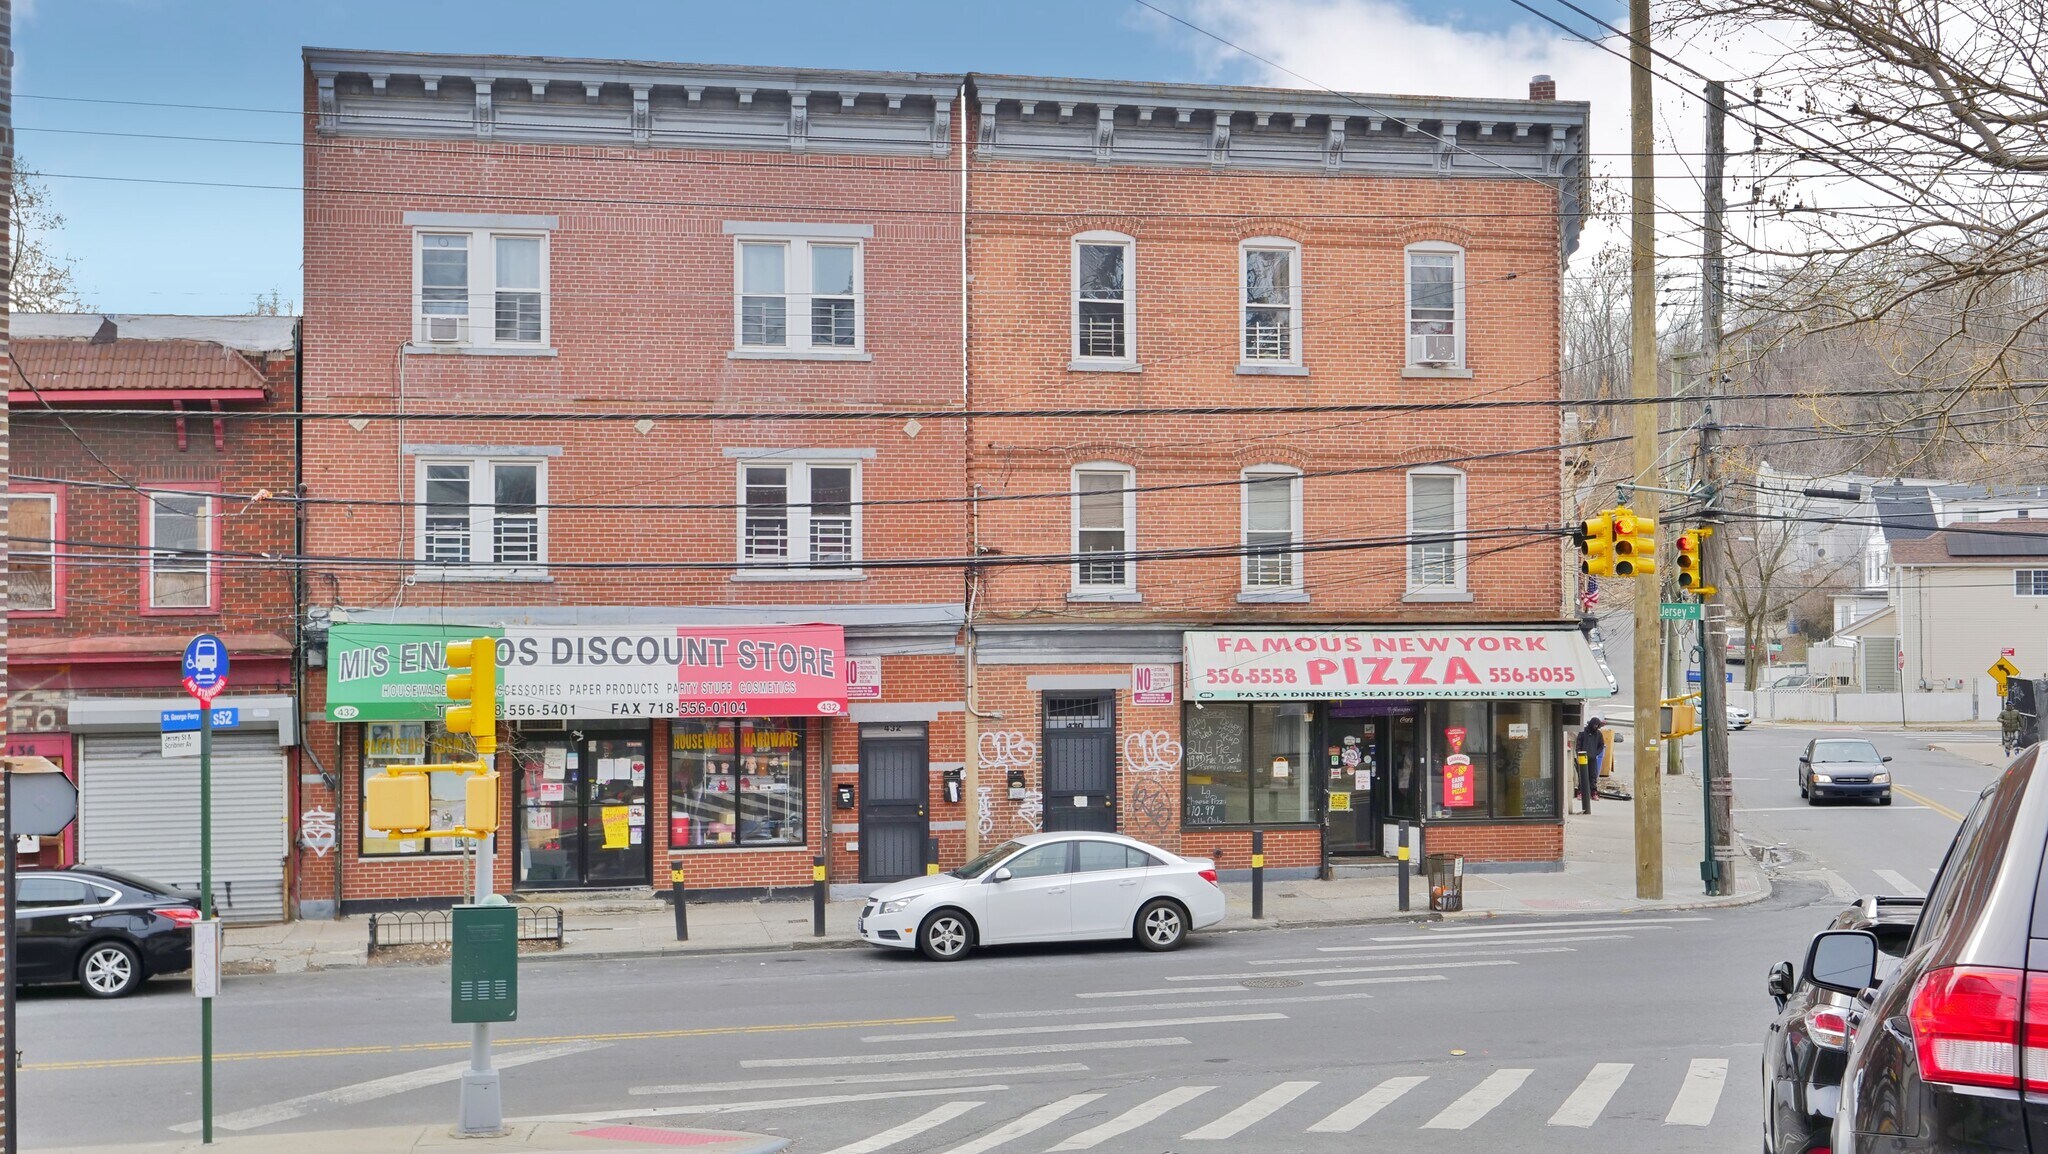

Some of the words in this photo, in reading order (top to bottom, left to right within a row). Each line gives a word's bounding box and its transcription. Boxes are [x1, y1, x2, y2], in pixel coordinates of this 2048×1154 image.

[1660, 604, 1687, 619] Jersey
[1217, 637, 1362, 653] FAMOUS
[1373, 637, 1450, 652] NEW
[1455, 637, 1548, 651] YORK
[339, 645, 390, 682] MIS
[399, 637, 539, 673] ENOS
[551, 636, 728, 668] DISCOUNT
[738, 639, 836, 679] STORE
[1206, 668, 1297, 684] 556-5558
[1306, 656, 1482, 685] PIZZA
[1489, 667, 1575, 682] 556-5055
[1136, 667, 1151, 691] NO
[382, 684, 447, 698] HOUSEWARE
[495, 684, 561, 697] CCESSORIES
[570, 683, 602, 696] PAPER
[606, 682, 659, 695] PRODUCTS
[667, 681, 698, 695] PARTY
[701, 681, 733, 694] STUFF
[738, 680, 797, 695] COSMETICS
[337, 707, 356, 718] 432
[495, 703, 577, 716] 8-556-5401
[611, 702, 642, 715] FAX
[648, 701, 747, 715] 718-556-0104
[820, 702, 838, 712] 432
[673, 733, 735, 750] HOUSEWARES
[743, 731, 798, 748] HARDWARE
